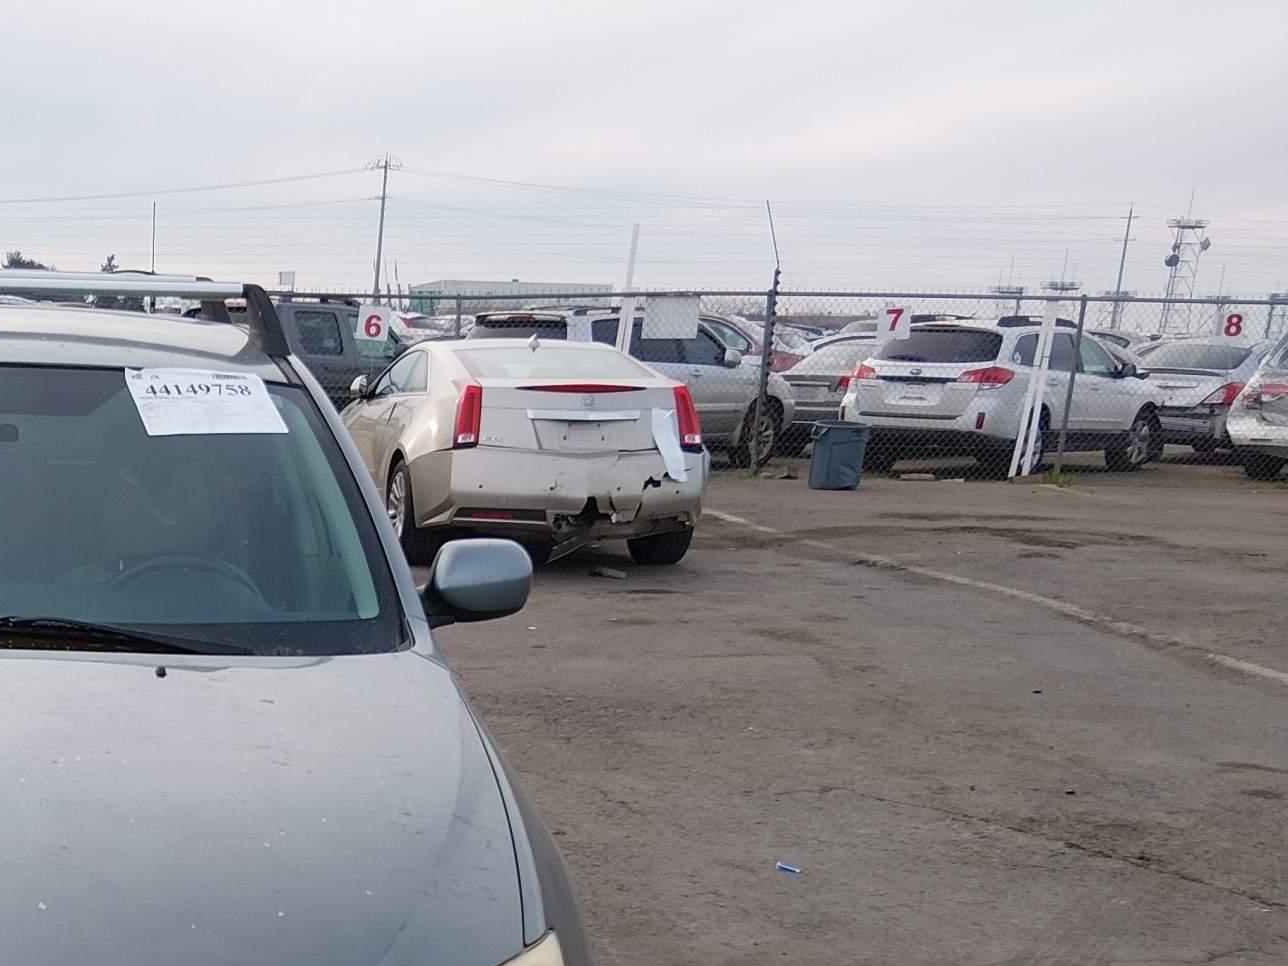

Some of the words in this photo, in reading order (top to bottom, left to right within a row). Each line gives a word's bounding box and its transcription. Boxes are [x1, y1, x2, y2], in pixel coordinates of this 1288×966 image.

[364, 314, 382, 338] 6
[886, 308, 904, 331] 7
[1224, 313, 1243, 336] 8
[145, 383, 252, 397] 44149758
